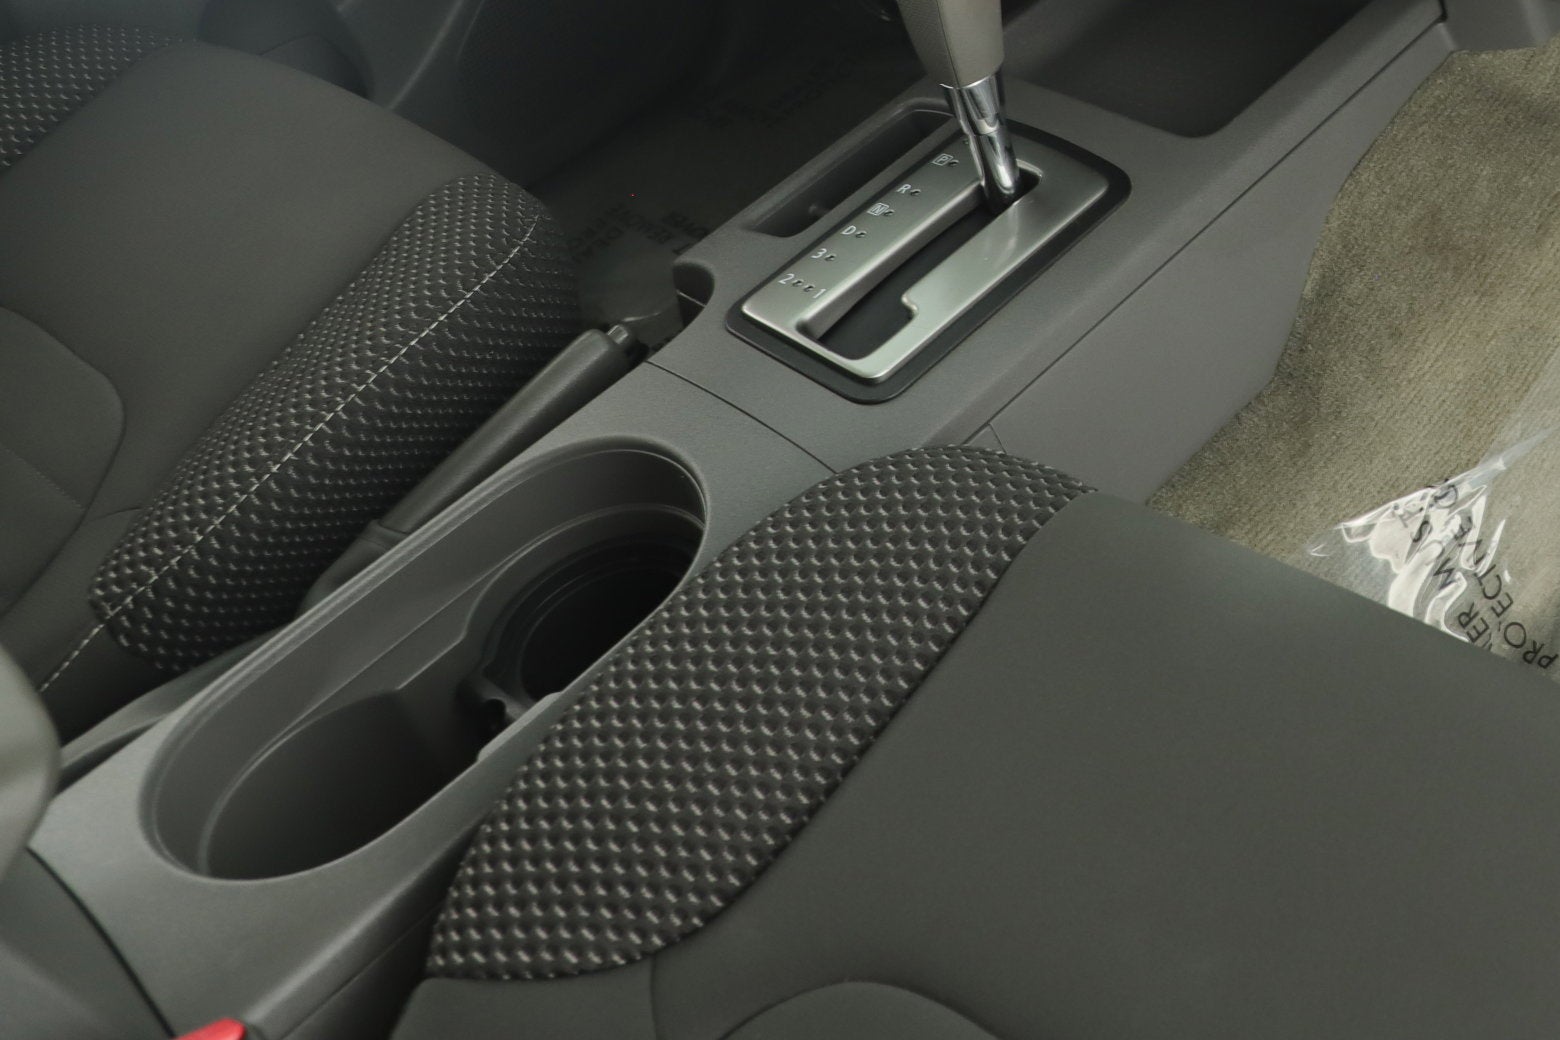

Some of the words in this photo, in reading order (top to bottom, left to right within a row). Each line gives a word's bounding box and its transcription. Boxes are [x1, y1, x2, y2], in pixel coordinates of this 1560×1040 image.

[897, 184, 911, 194] R
[842, 225, 857, 235] D
[811, 248, 827, 259] 3
[778, 274, 794, 284] 2
[813, 288, 827, 298] 1
